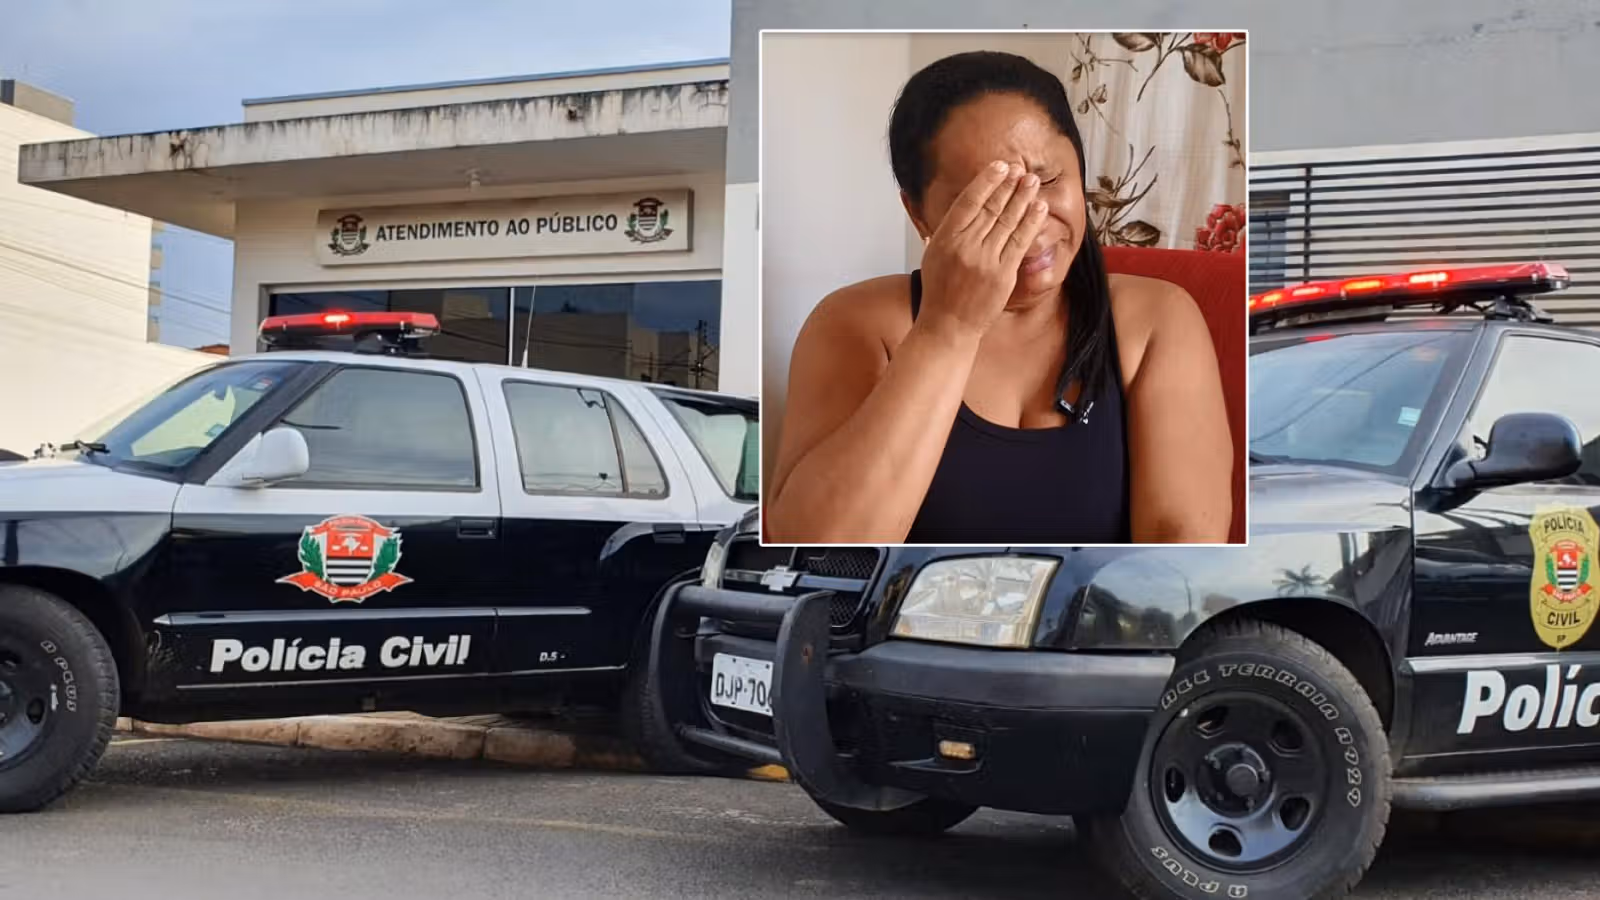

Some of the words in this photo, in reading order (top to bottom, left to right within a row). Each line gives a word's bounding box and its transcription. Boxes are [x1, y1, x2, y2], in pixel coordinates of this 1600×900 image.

[376, 219, 500, 241] ATENDIMENTO
[505, 218, 530, 236] AO
[536, 212, 618, 234] PÚBLICO
[1547, 610, 1581, 627] CIVIL
[210, 639, 366, 672] Polícia
[380, 635, 471, 668] Civil
[1161, 670, 1210, 709] ALL
[1218, 663, 1340, 720] TERRAIN
[1150, 846, 1219, 893] PLUS
